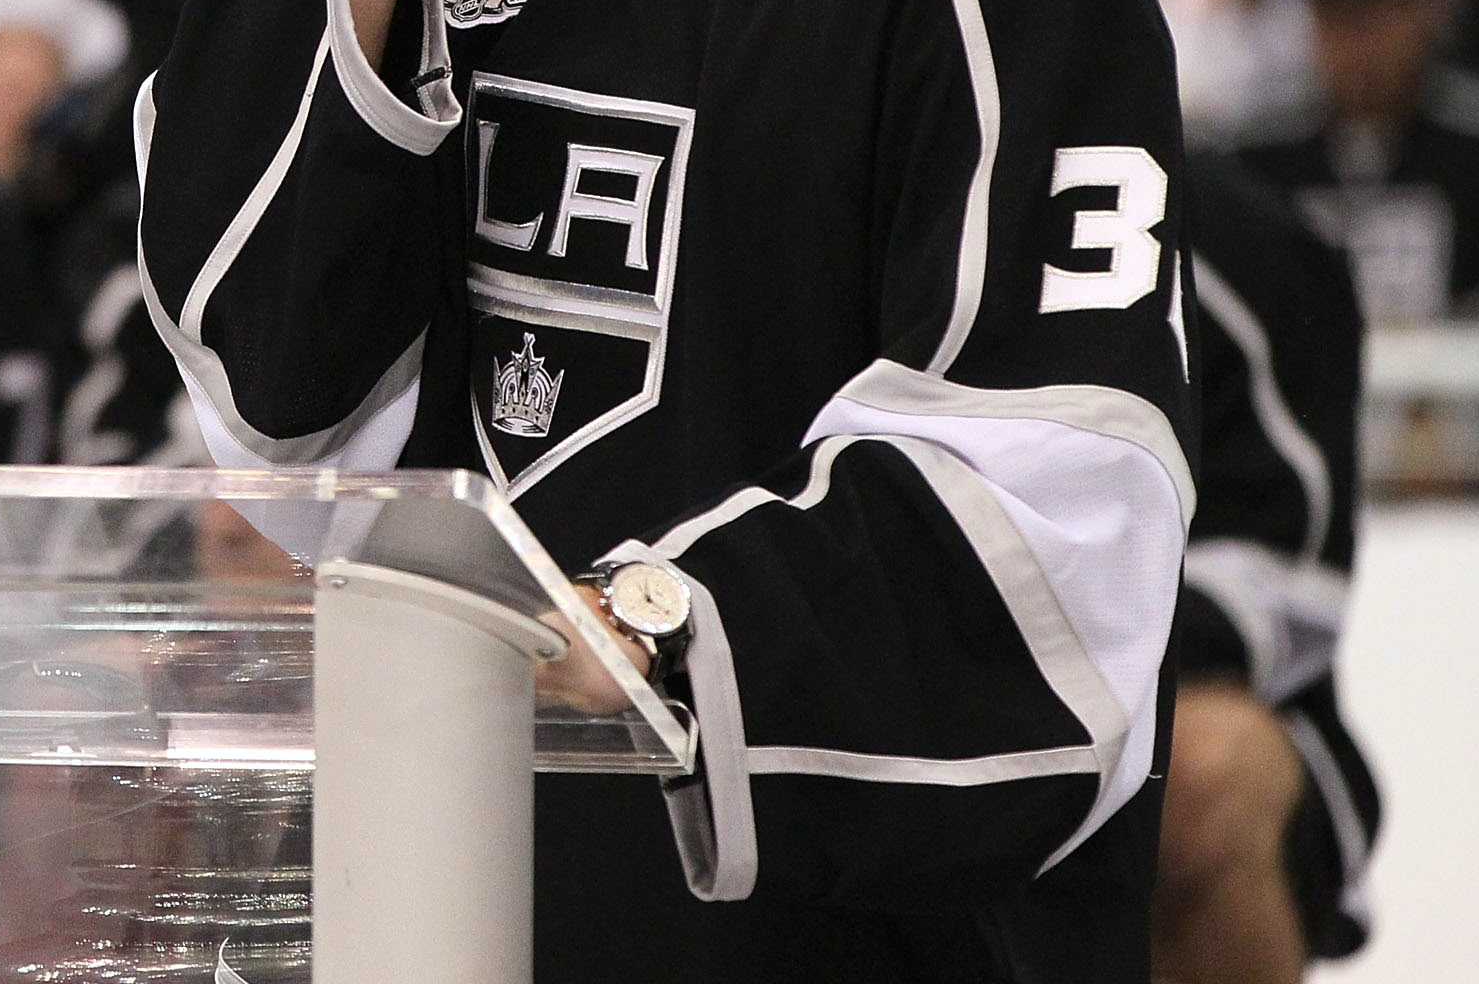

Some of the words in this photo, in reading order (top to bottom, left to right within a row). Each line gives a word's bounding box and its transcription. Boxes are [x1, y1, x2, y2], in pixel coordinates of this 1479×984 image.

[460, 0, 481, 12] NHL
[475, 118, 666, 271] LA
[1037, 145, 1191, 386] 3
